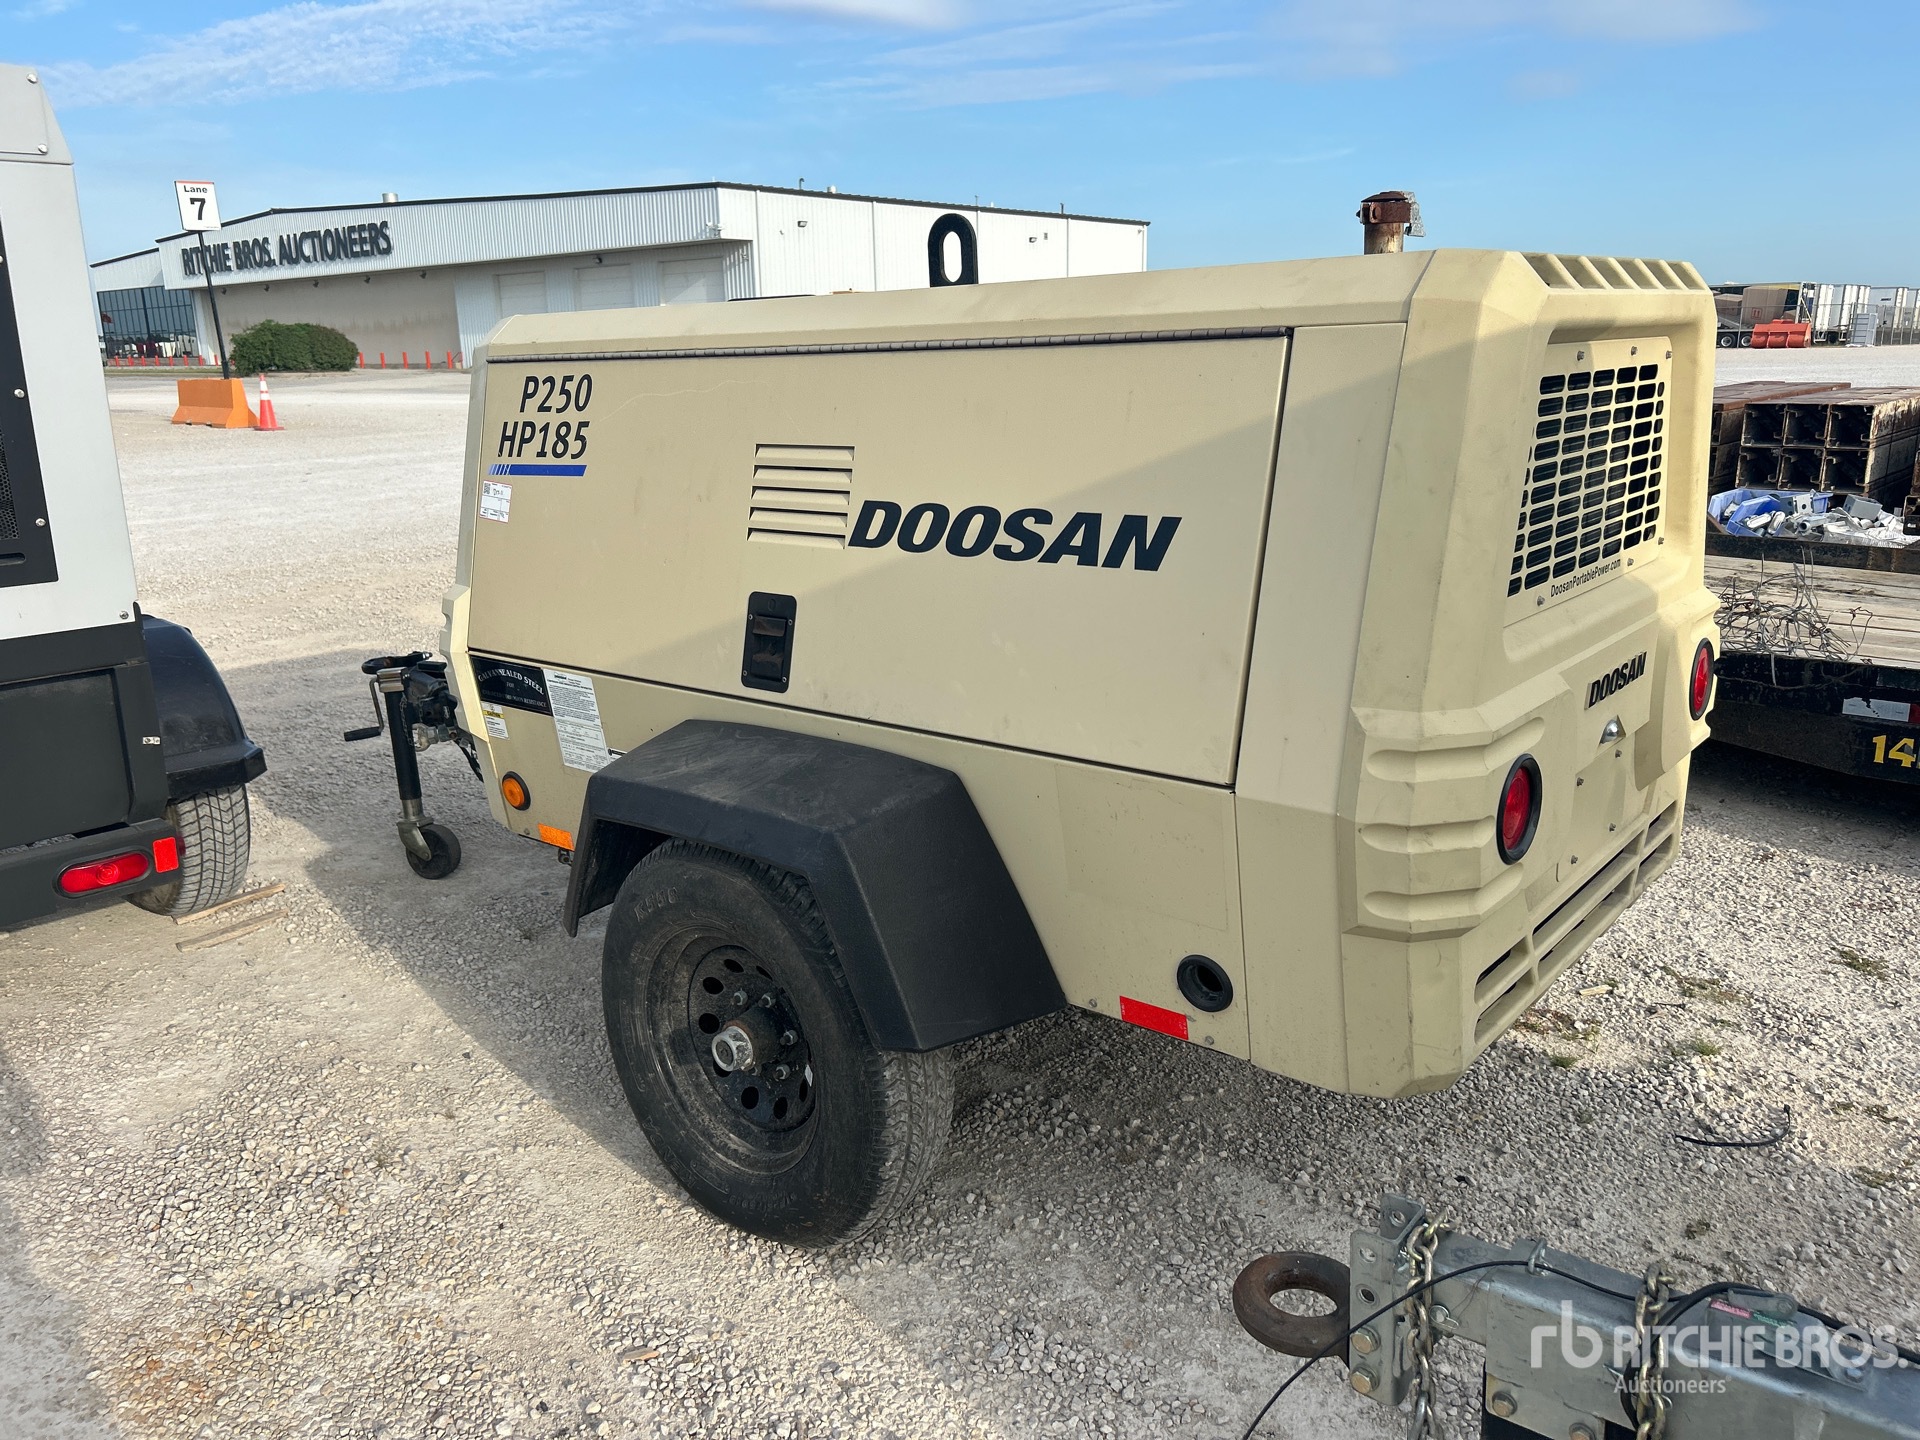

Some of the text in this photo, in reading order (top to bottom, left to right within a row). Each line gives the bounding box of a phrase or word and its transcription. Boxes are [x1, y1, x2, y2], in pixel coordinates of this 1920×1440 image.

[183, 185, 208, 193] Lane
[189, 197, 206, 220] 7
[181, 220, 393, 276] RITCHIE BROS. AUCTIONEERS
[520, 373, 592, 414] P250
[498, 421, 590, 460] HP185
[848, 500, 1182, 571] DOOSAN
[1551, 558, 1621, 597] DoosanPortablePower.com
[523, 676, 544, 695] STEEL
[1586, 651, 1647, 709] DOOSAN
